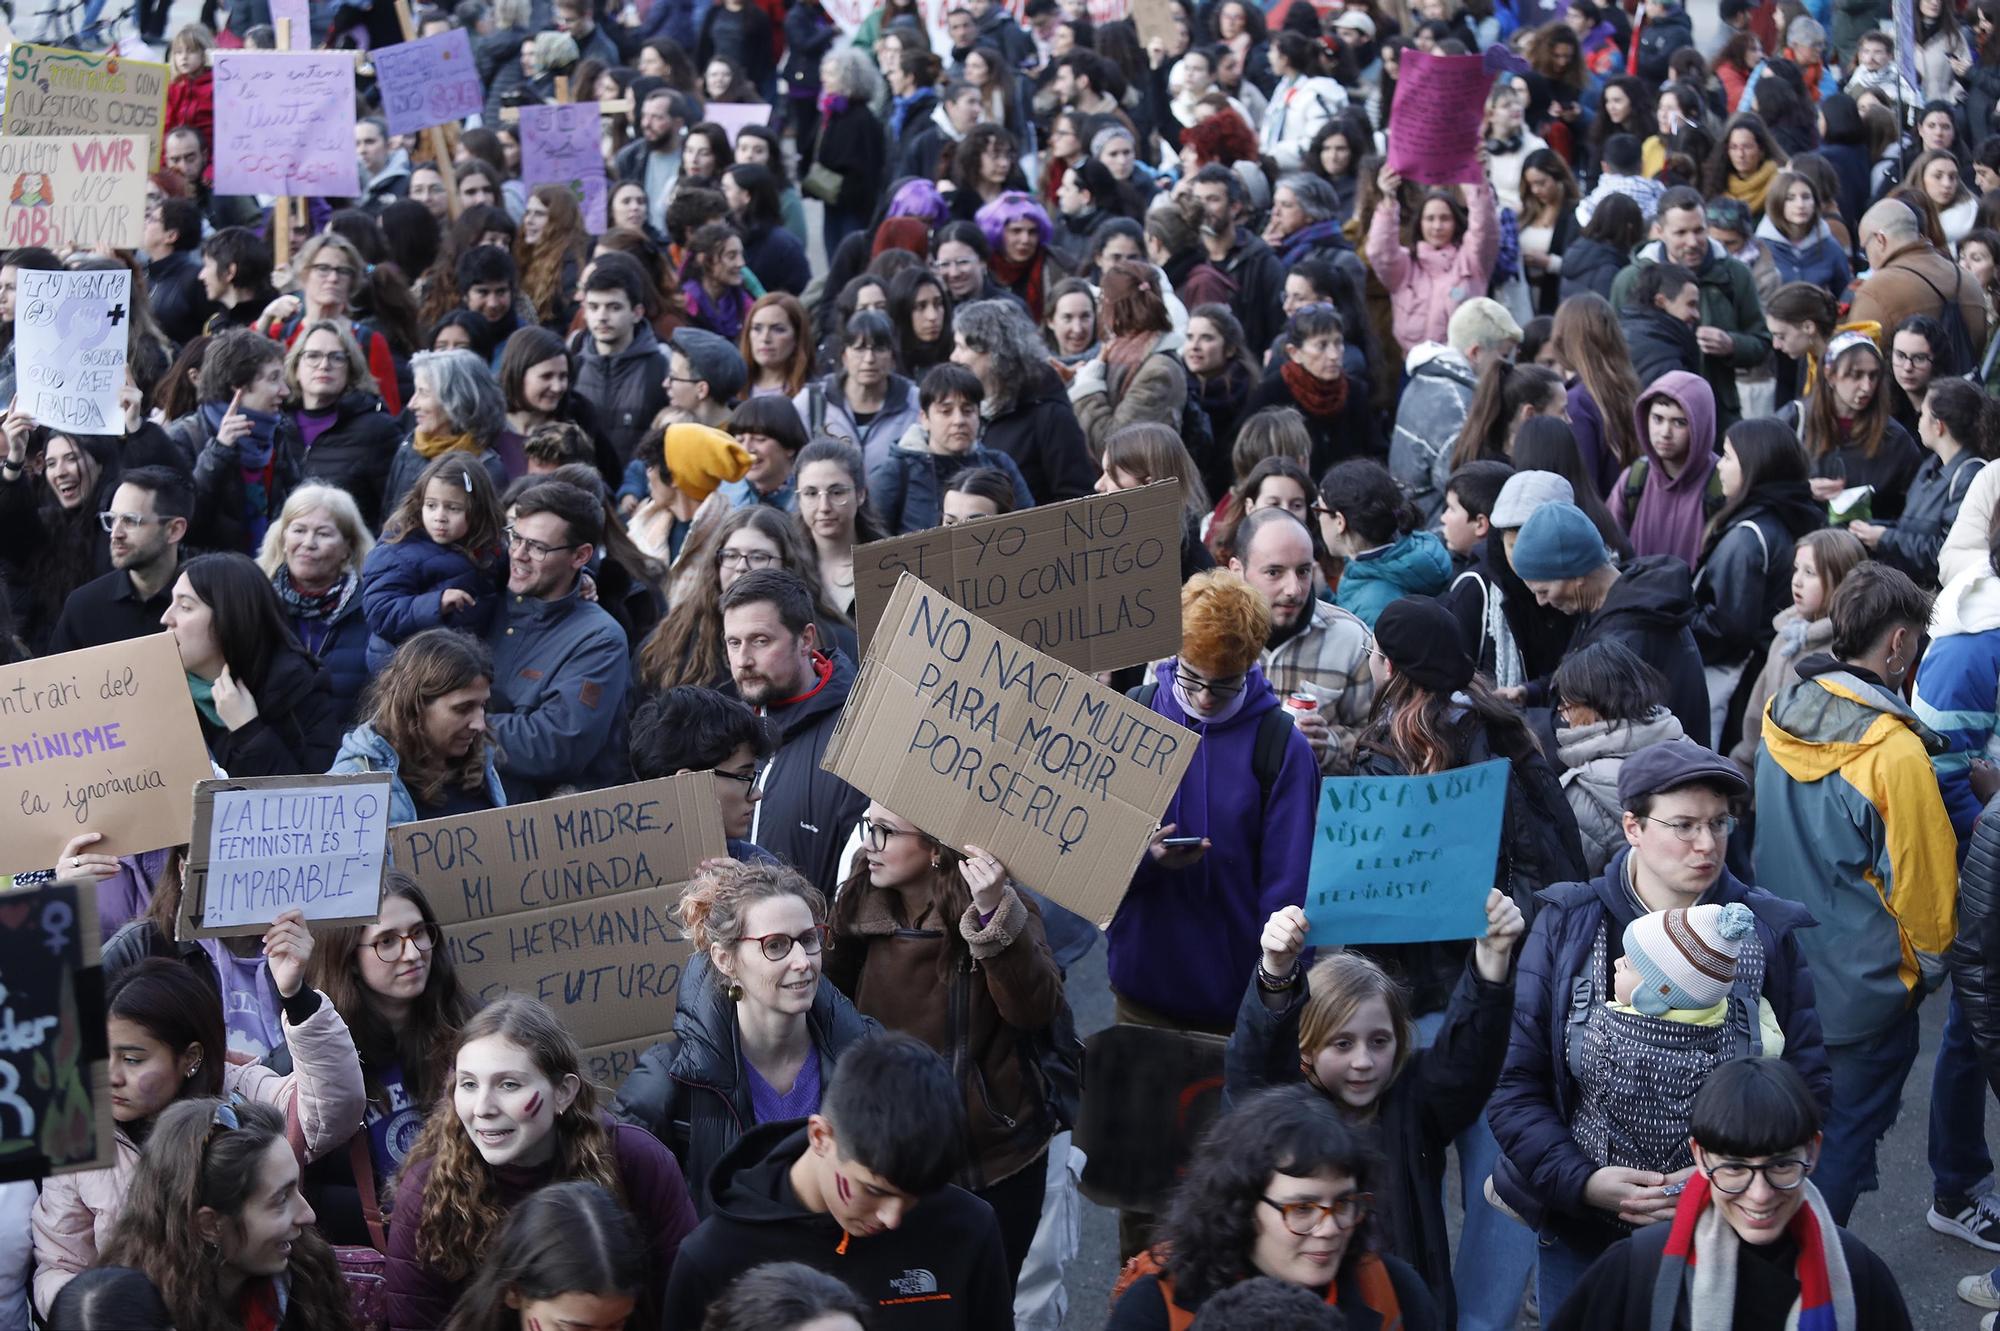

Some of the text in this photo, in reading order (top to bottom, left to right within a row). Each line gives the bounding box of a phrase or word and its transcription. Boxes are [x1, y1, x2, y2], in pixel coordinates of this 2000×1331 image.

[136, 73, 160, 96] CON
[10, 89, 99, 123] NUESTROS
[107, 100, 158, 127] OJOS
[72, 136, 136, 173] VIVIR
[24, 272, 64, 298] TU
[35, 392, 106, 428] FALDA
[878, 502, 1128, 588] SI YO NO
[1019, 538, 1163, 600] CONTIGO
[100, 666, 139, 700] del
[909, 595, 1178, 776] NO NACÍ MUJER
[915, 662, 1117, 801] PARA MORIR
[20, 790, 49, 815] la
[220, 795, 345, 833] LA LLUITA
[1327, 779, 1414, 813] VISCA
[218, 833, 312, 860] FEMINISTA
[406, 800, 674, 875] POR MI MADRE,
[1325, 821, 1436, 847] VISCA LA
[1356, 847, 1443, 871] LLUITA
[219, 857, 361, 910] IMPARABLE
[462, 851, 663, 917] MI CUÑADA,
[509, 902, 684, 963] HERMANAS
[537, 964, 681, 1004] FUTURO
